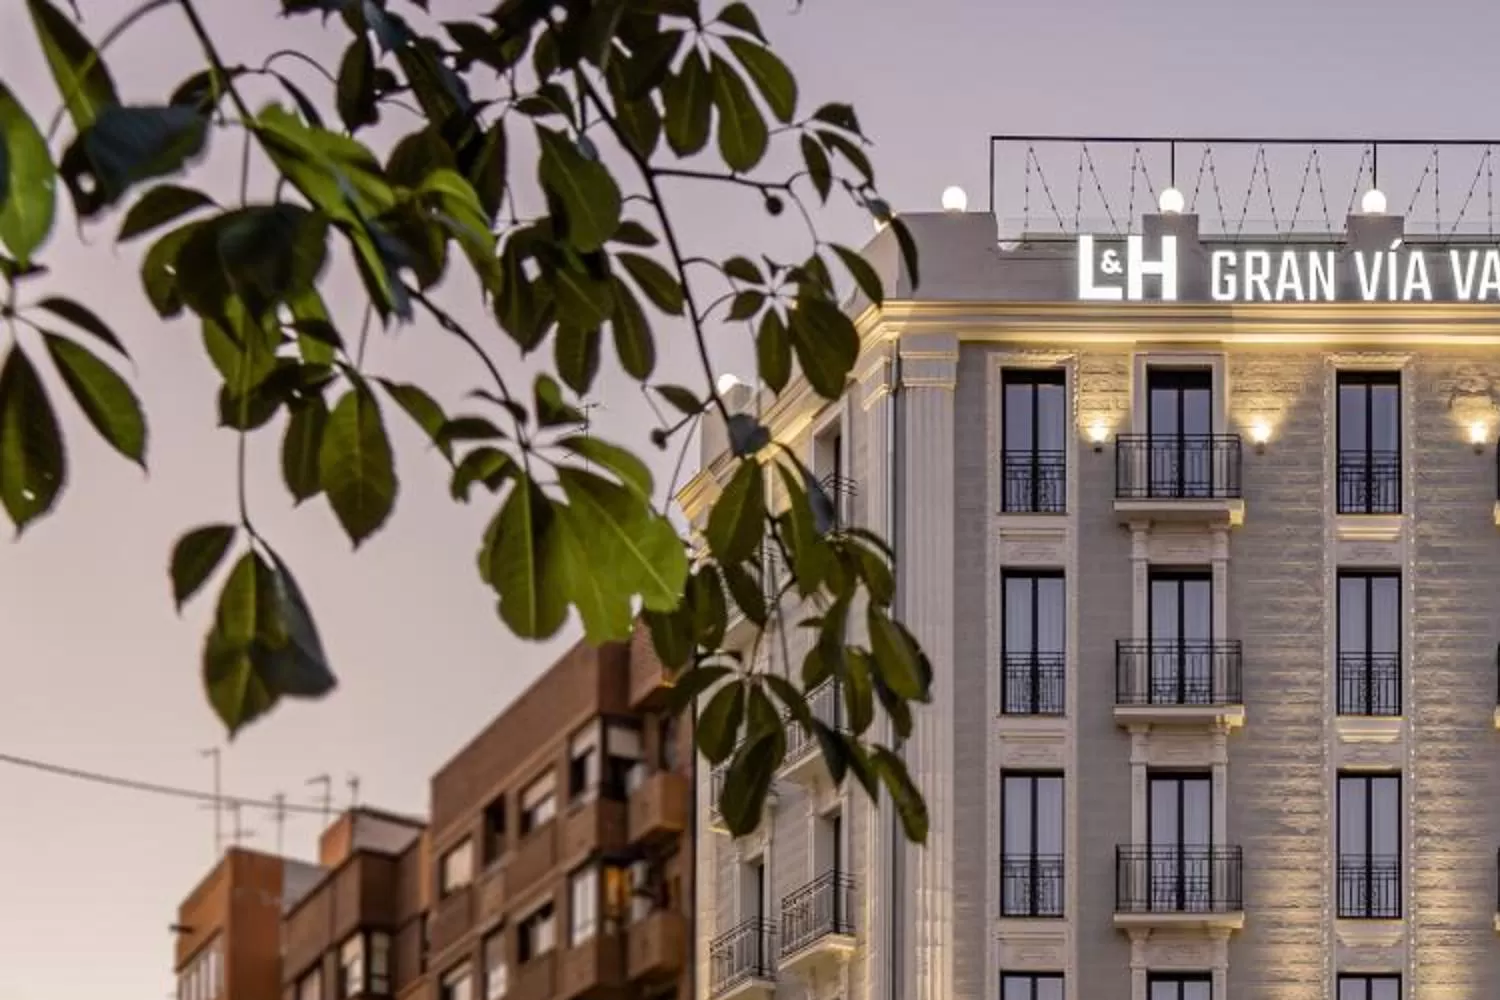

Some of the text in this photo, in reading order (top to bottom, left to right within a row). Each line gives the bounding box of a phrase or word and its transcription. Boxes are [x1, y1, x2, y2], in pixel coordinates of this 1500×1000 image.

[1078, 235, 1177, 301] L&H
[1211, 250, 1335, 301] GRAN
[1354, 239, 1432, 301] VÍA
